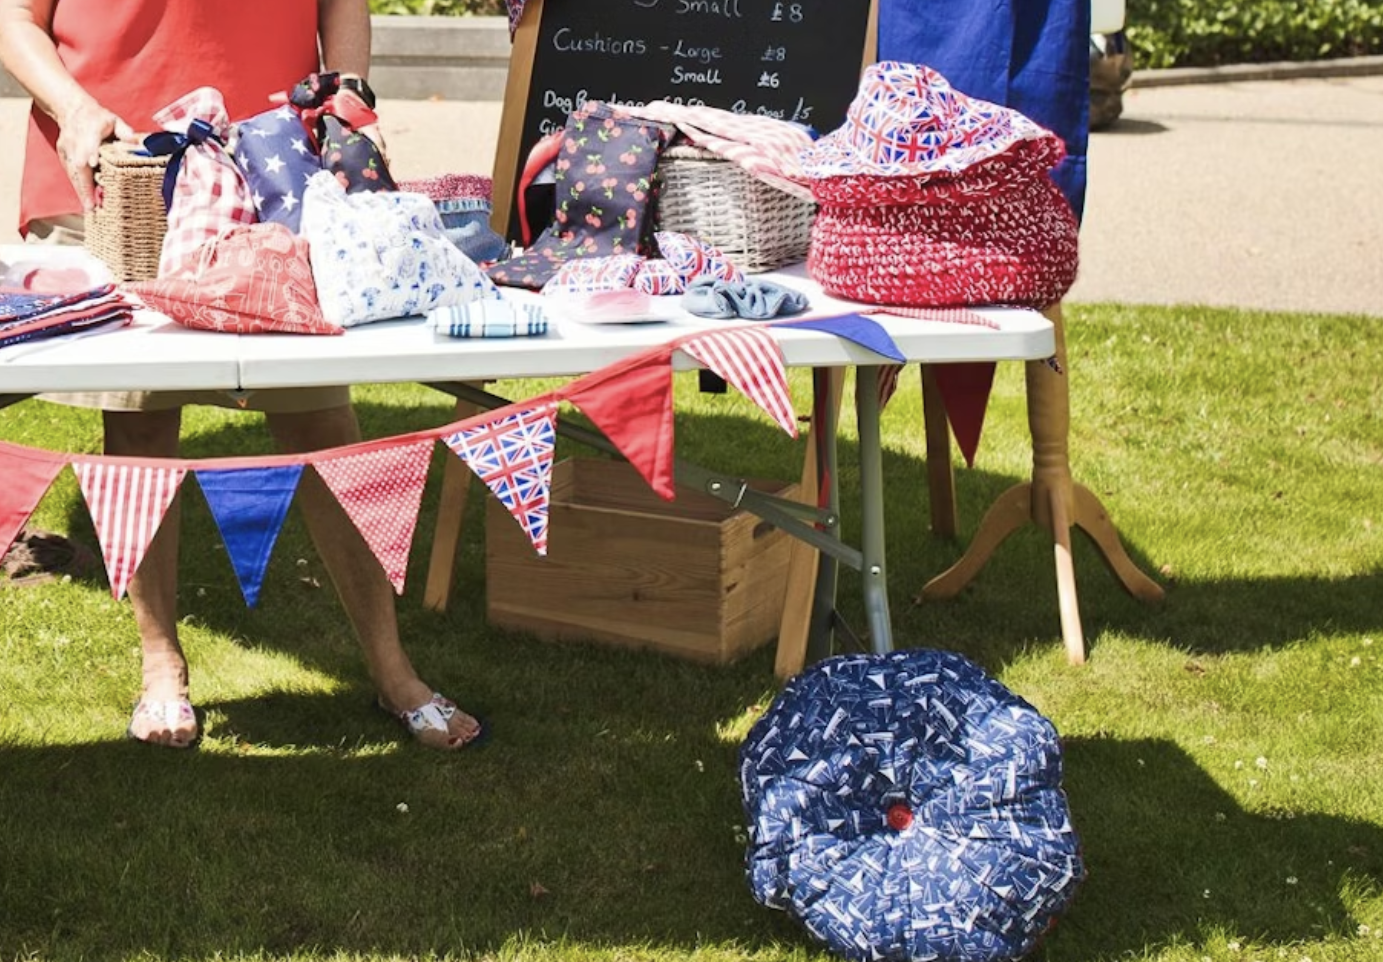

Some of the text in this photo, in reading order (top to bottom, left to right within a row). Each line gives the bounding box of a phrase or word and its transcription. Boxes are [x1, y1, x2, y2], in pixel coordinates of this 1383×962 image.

[552, 27, 647, 55] Cushions
[673, 39, 723, 64] Large
[760, 46, 786, 62] £8
[670, 65, 780, 89] Small £6
[543, 89, 573, 115] Dog
